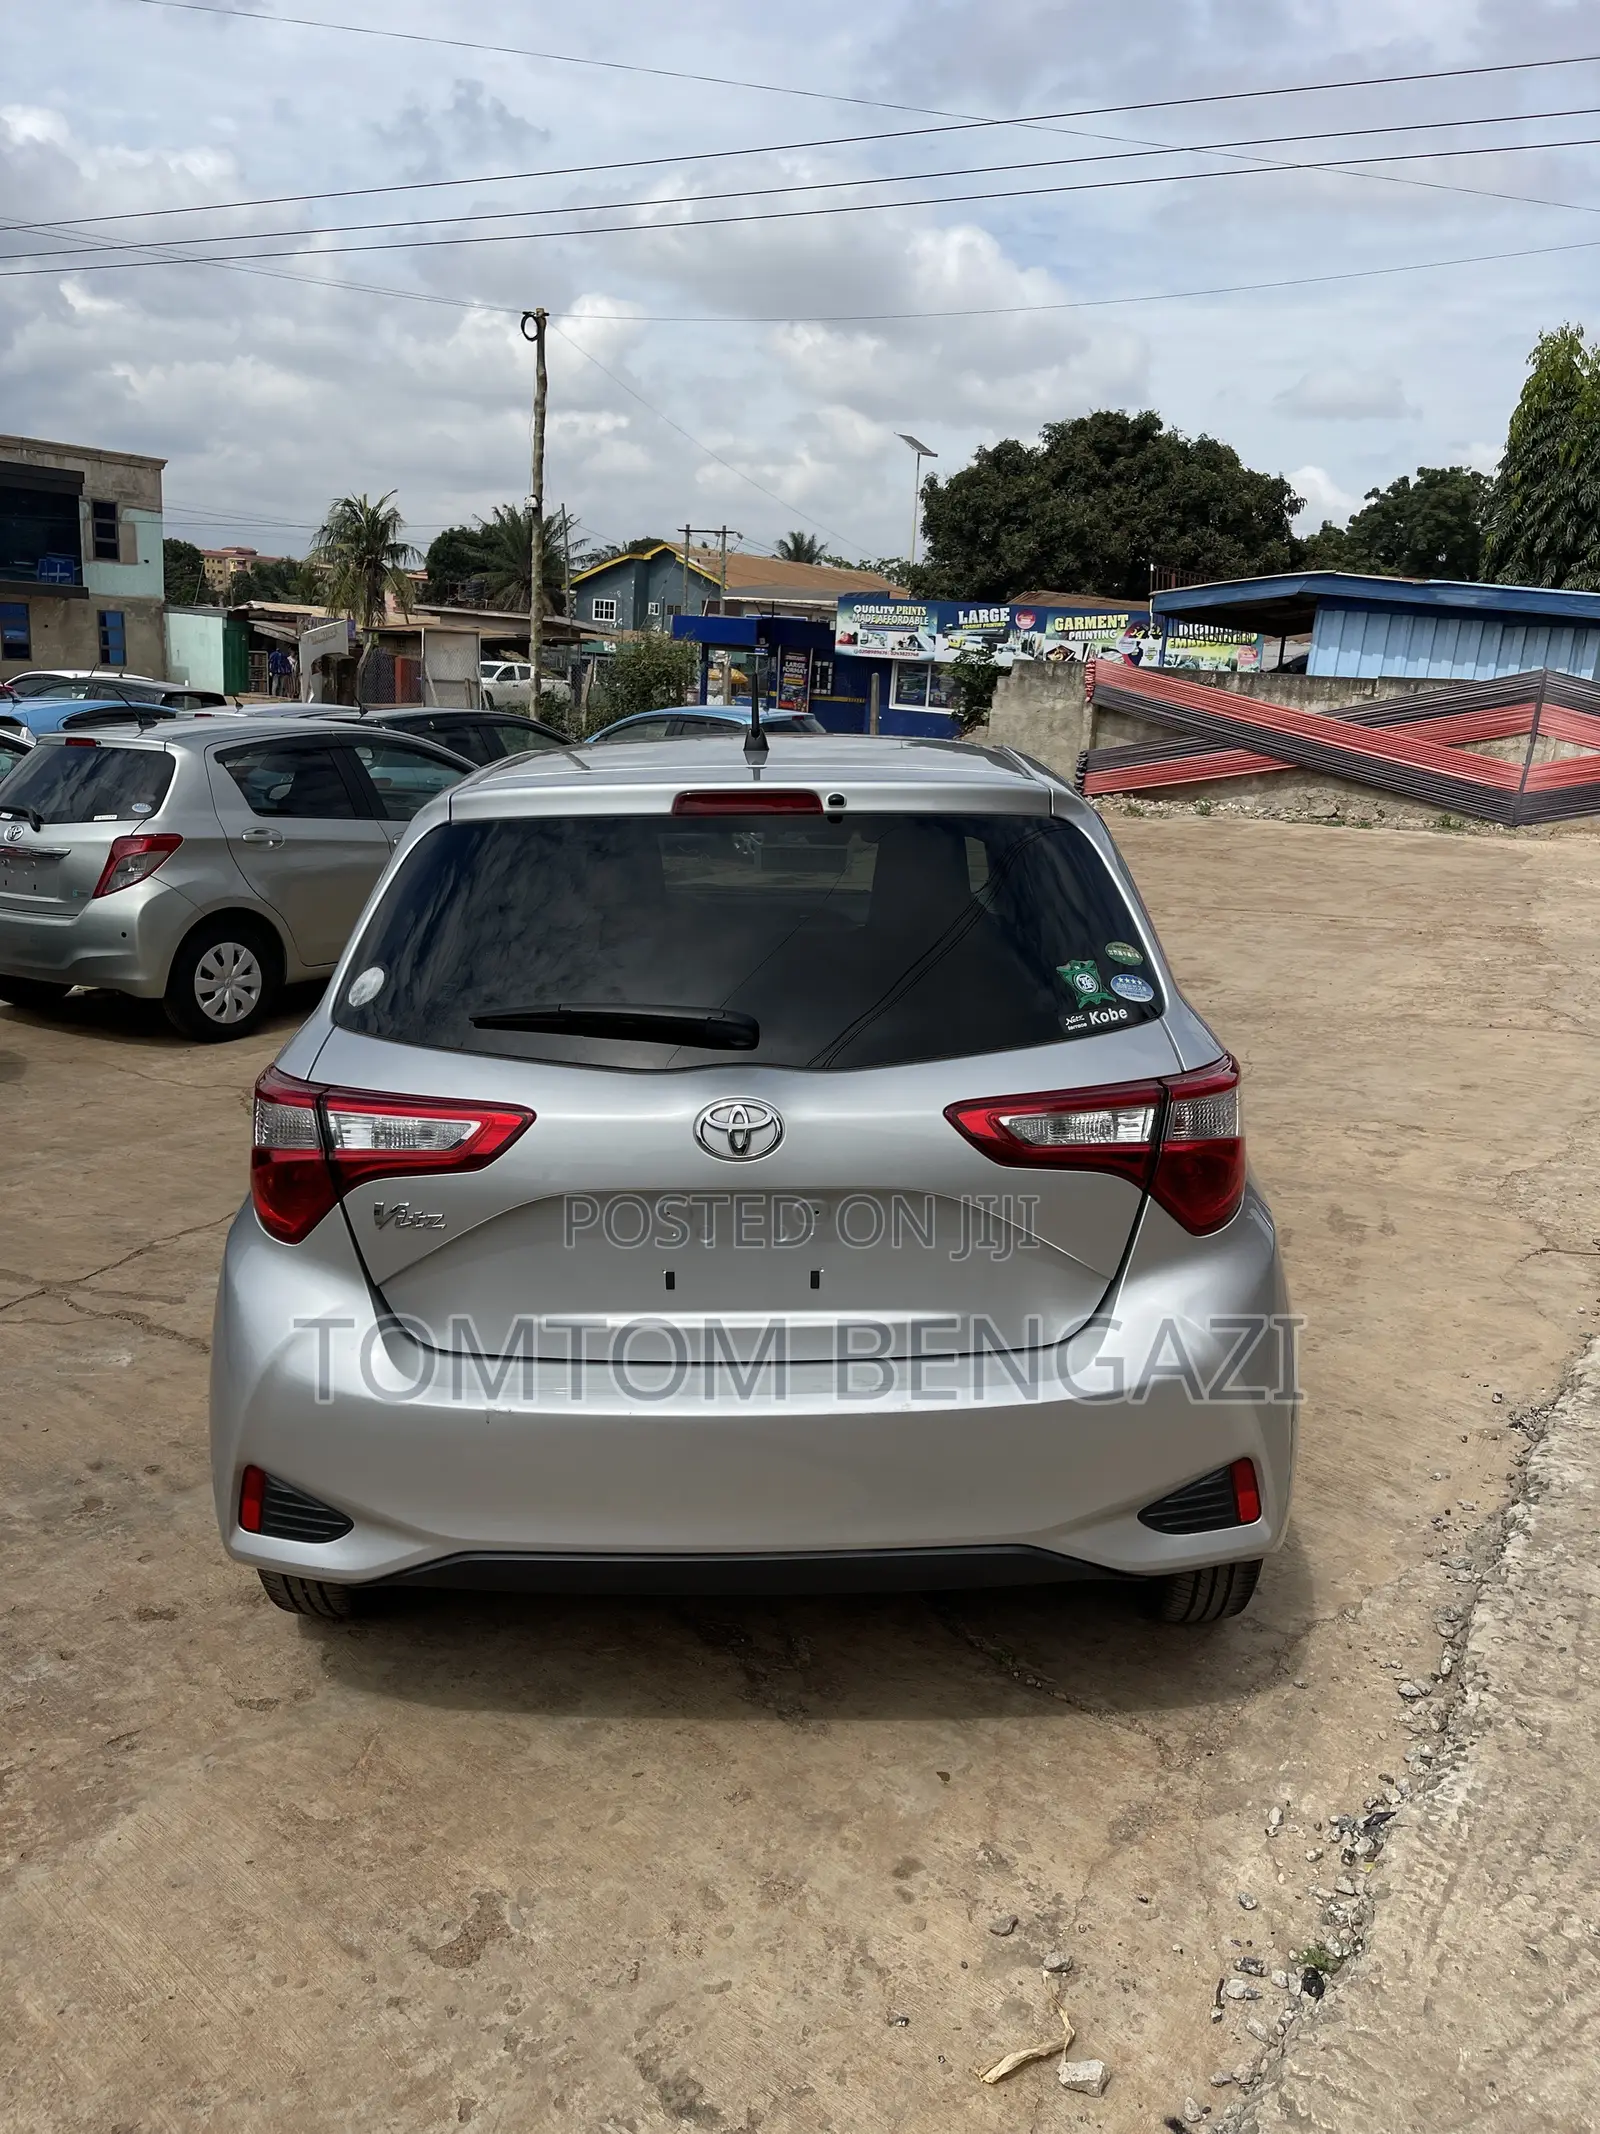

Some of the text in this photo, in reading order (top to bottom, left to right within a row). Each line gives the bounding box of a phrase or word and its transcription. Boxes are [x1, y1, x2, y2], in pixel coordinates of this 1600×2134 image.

[853, 604, 927, 616] QUALITY PRINTS
[958, 607, 1010, 624] LARGE
[852, 613, 929, 626] MADE AFFORDABLE
[1054, 614, 1129, 631] GARMENT
[1068, 629, 1118, 641] PRINTING
[782, 666, 808, 675] FORMAT
[785, 661, 806, 669] LARGE
[1088, 1007, 1128, 1025] Kobe
[373, 1202, 448, 1231] Vitz
